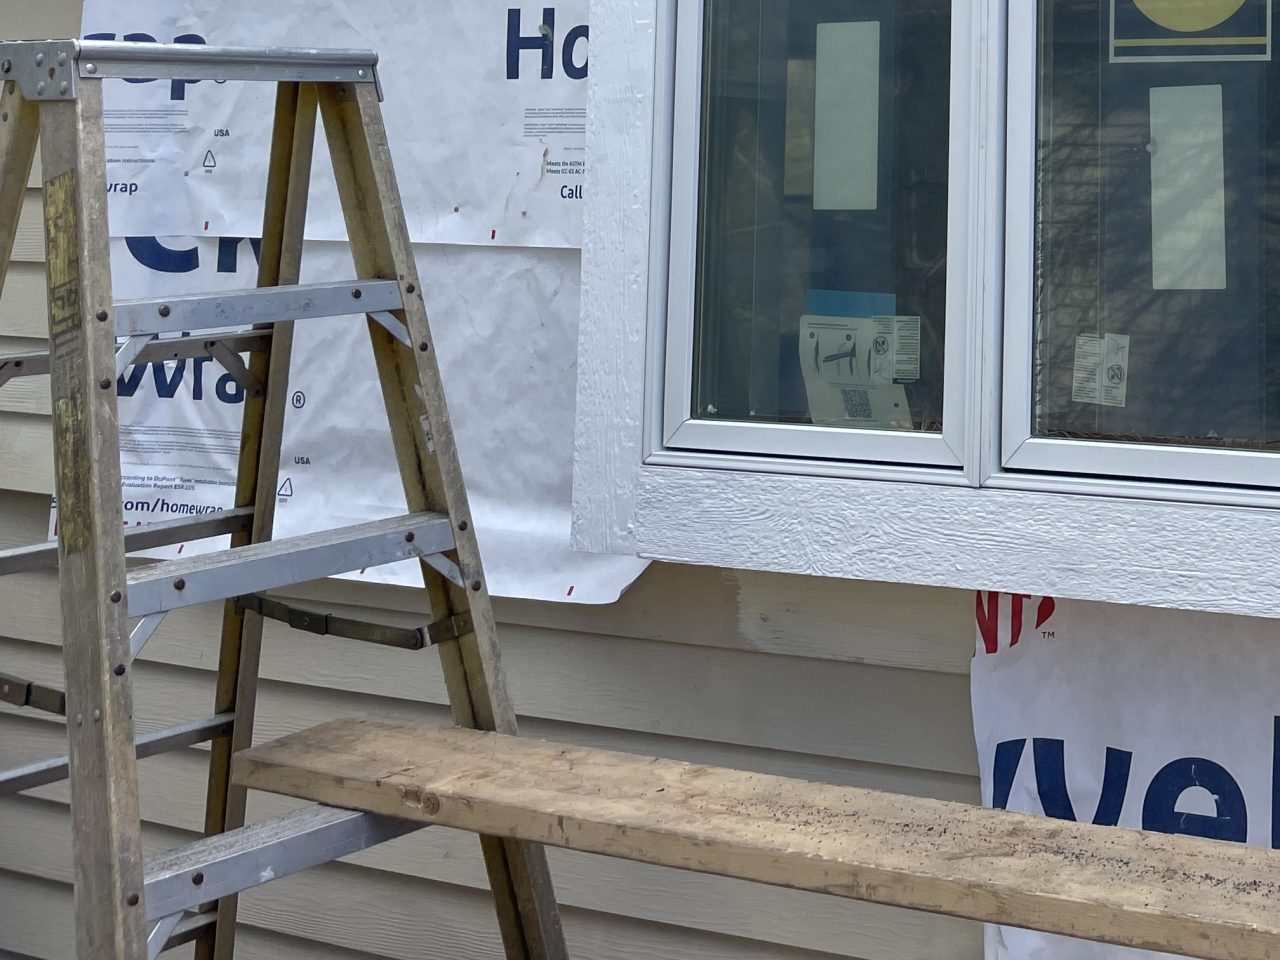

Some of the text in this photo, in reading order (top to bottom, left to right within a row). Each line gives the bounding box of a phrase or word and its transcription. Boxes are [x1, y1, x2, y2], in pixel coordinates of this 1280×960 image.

[213, 128, 230, 137] USA
[560, 185, 583, 199] Call
[294, 456, 311, 465] USA
